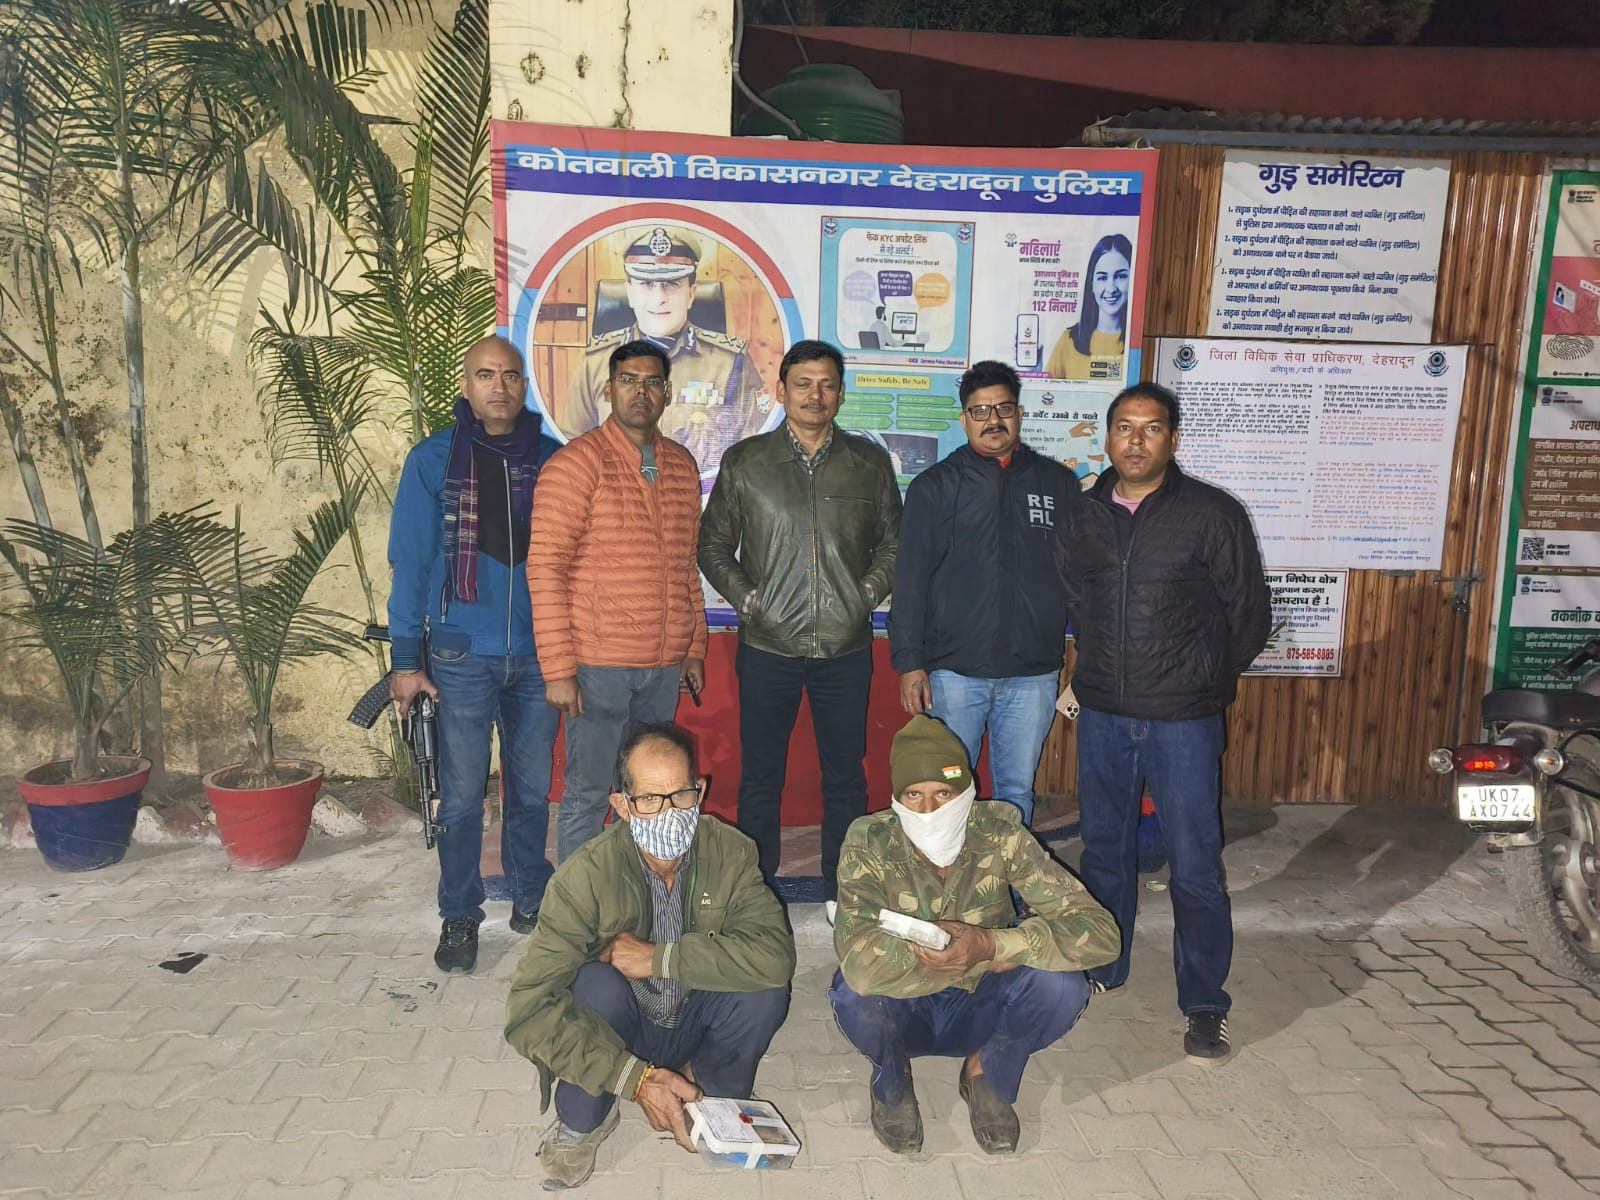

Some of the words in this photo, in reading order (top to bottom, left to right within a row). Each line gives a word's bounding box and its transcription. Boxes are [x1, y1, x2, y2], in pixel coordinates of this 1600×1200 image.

[517, 148, 675, 180] कोतवाली
[685, 154, 882, 187] विकासनगर
[890, 164, 1023, 200] देहरादून
[1032, 169, 1131, 202] पुलिस
[1306, 160, 1405, 188] समेरिटन
[1019, 239, 1061, 256] महिलाएं
[1033, 301, 1046, 311] 112
[1209, 348, 1237, 361] जिला
[1244, 349, 1278, 362] विधिक
[1284, 349, 1305, 362] सेवा
[1372, 353, 1416, 369] देहरादून
[858, 376, 878, 384] Drive
[1027, 494, 1055, 510] RE
[1029, 509, 1054, 526] AL
[1286, 573, 1315, 584] निषेध
[1319, 574, 1338, 584] क्षेत्र
[1312, 595, 1321, 605] है
[1551, 606, 1593, 622] तकनीक
[1479, 788, 1519, 802] UK07
[1469, 804, 1531, 818] AX0744
